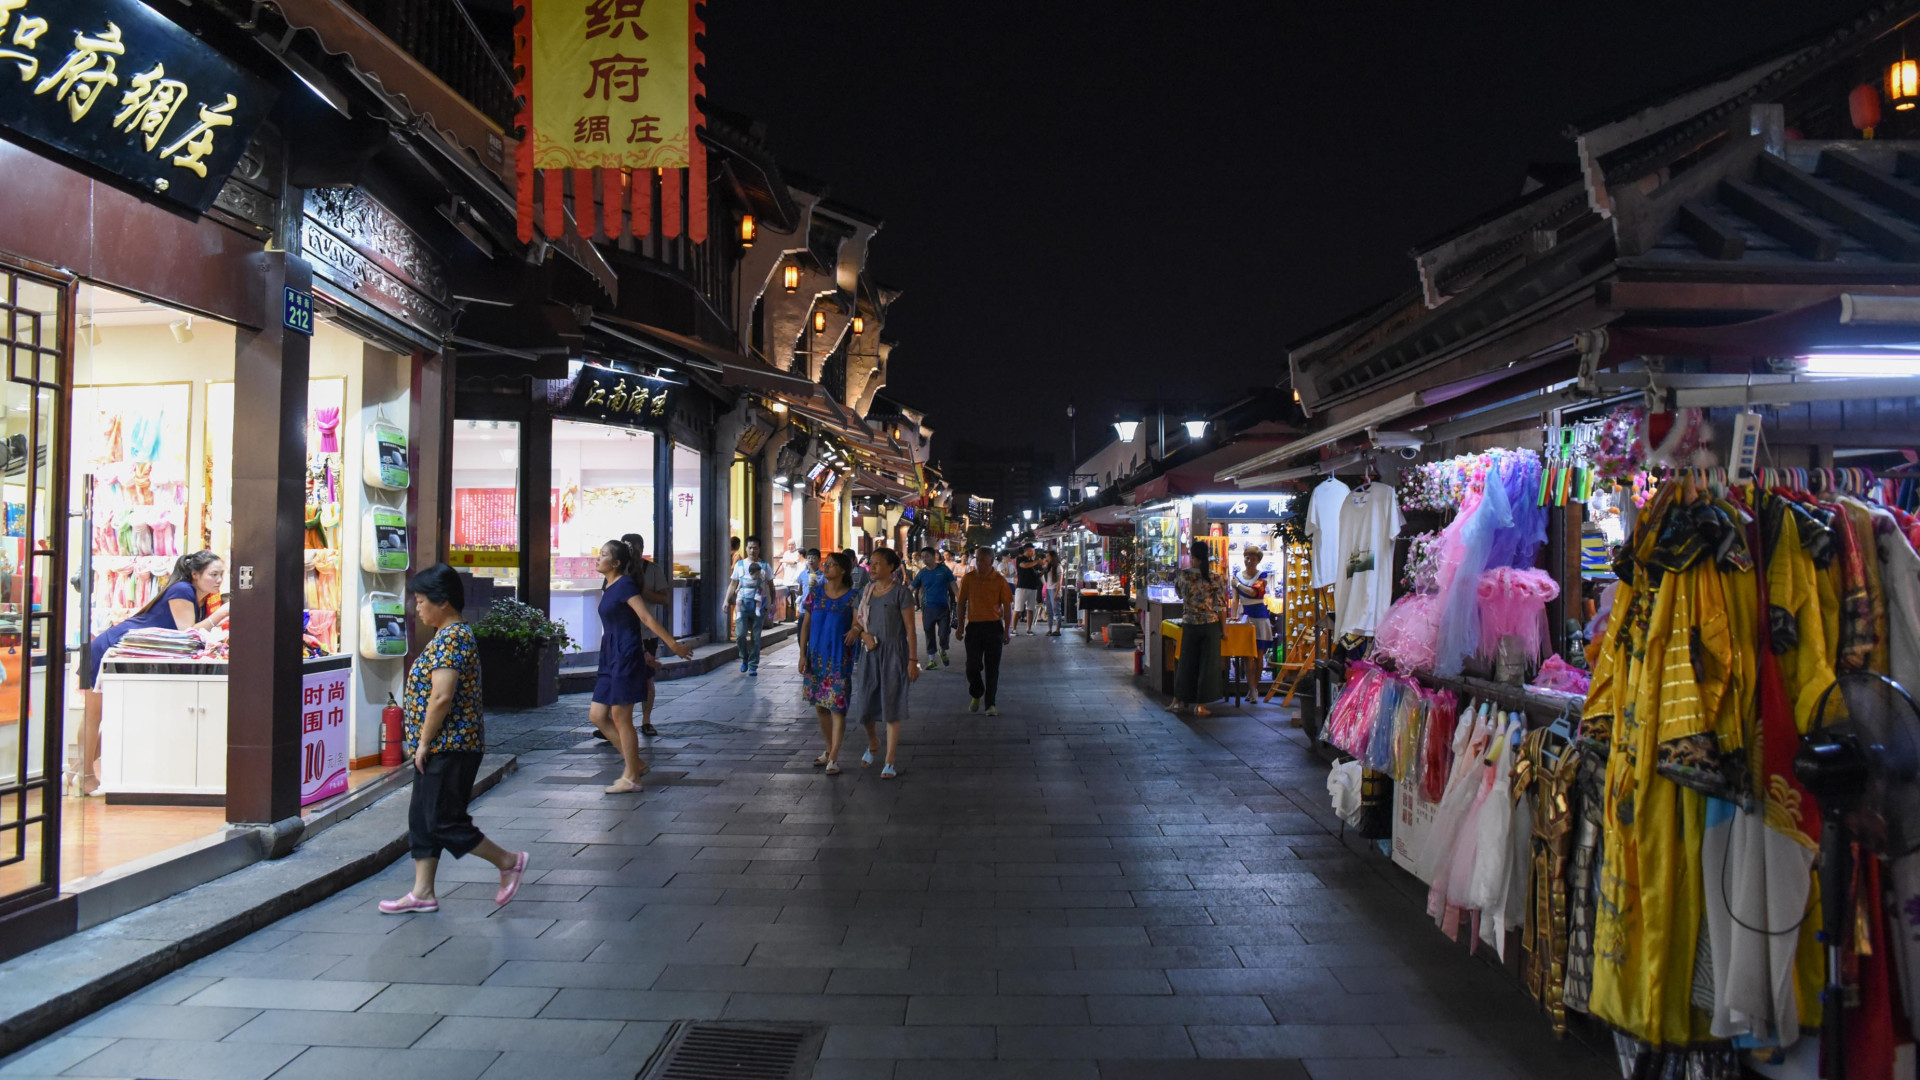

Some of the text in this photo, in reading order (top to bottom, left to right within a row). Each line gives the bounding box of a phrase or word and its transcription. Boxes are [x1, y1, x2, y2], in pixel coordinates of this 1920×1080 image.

[574, 115, 663, 144] 绸庄
[290, 306, 309, 328] 212
[303, 681, 345, 706] 时尚
[303, 707, 343, 734] 围巾
[303, 740, 325, 784] 10
